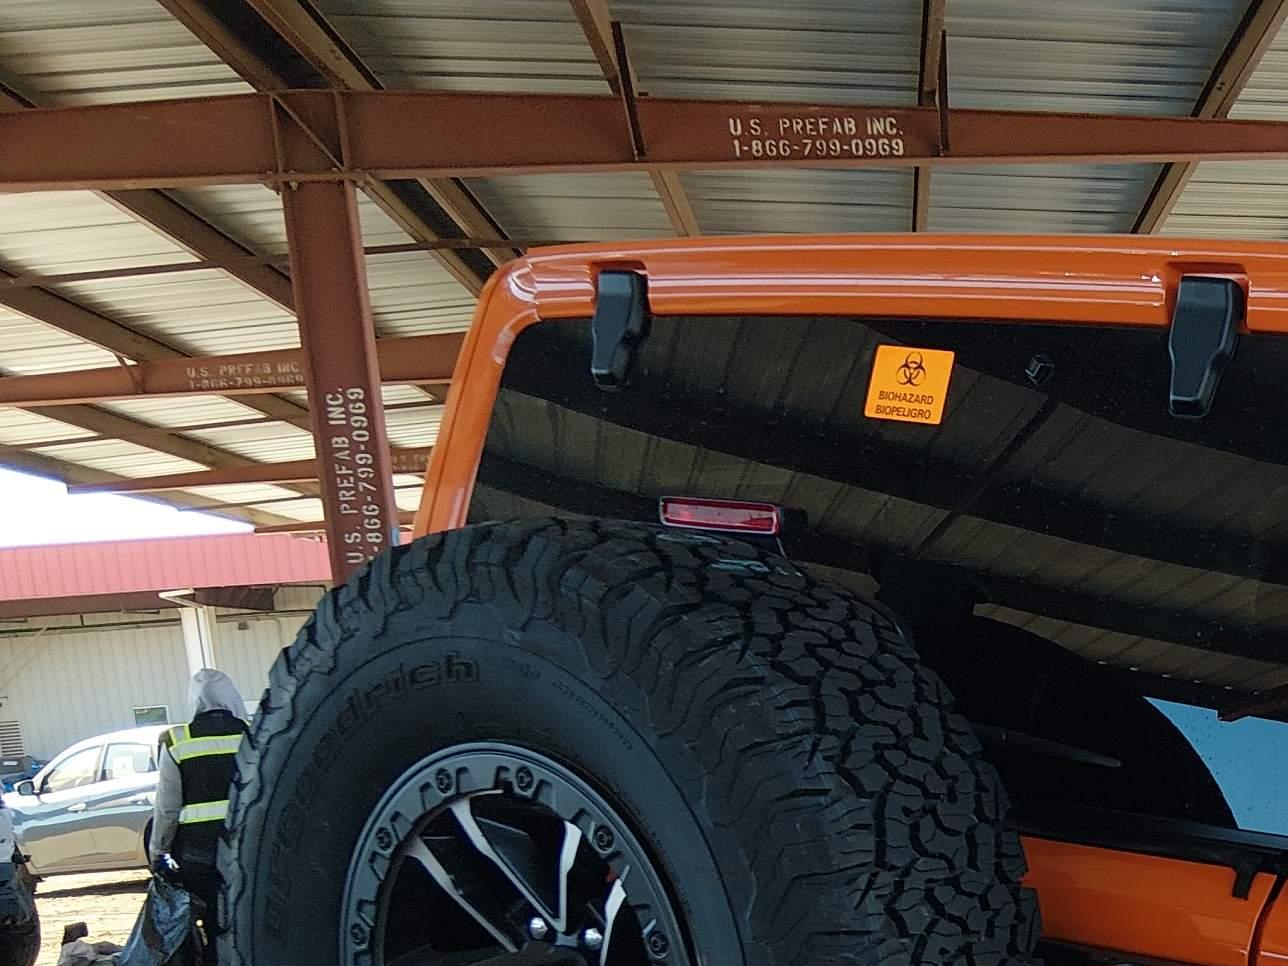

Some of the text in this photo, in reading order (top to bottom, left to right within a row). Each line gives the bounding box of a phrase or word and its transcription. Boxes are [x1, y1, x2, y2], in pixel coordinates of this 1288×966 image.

[728, 117, 904, 136] U.S. PREFAB INC.
[732, 138, 905, 158] 1-866-799-0969
[878, 390, 934, 405] BIOHAZARD
[875, 404, 932, 420] BIOPELIGRO
[326, 387, 365, 564] U.S. PREFAB INC.
